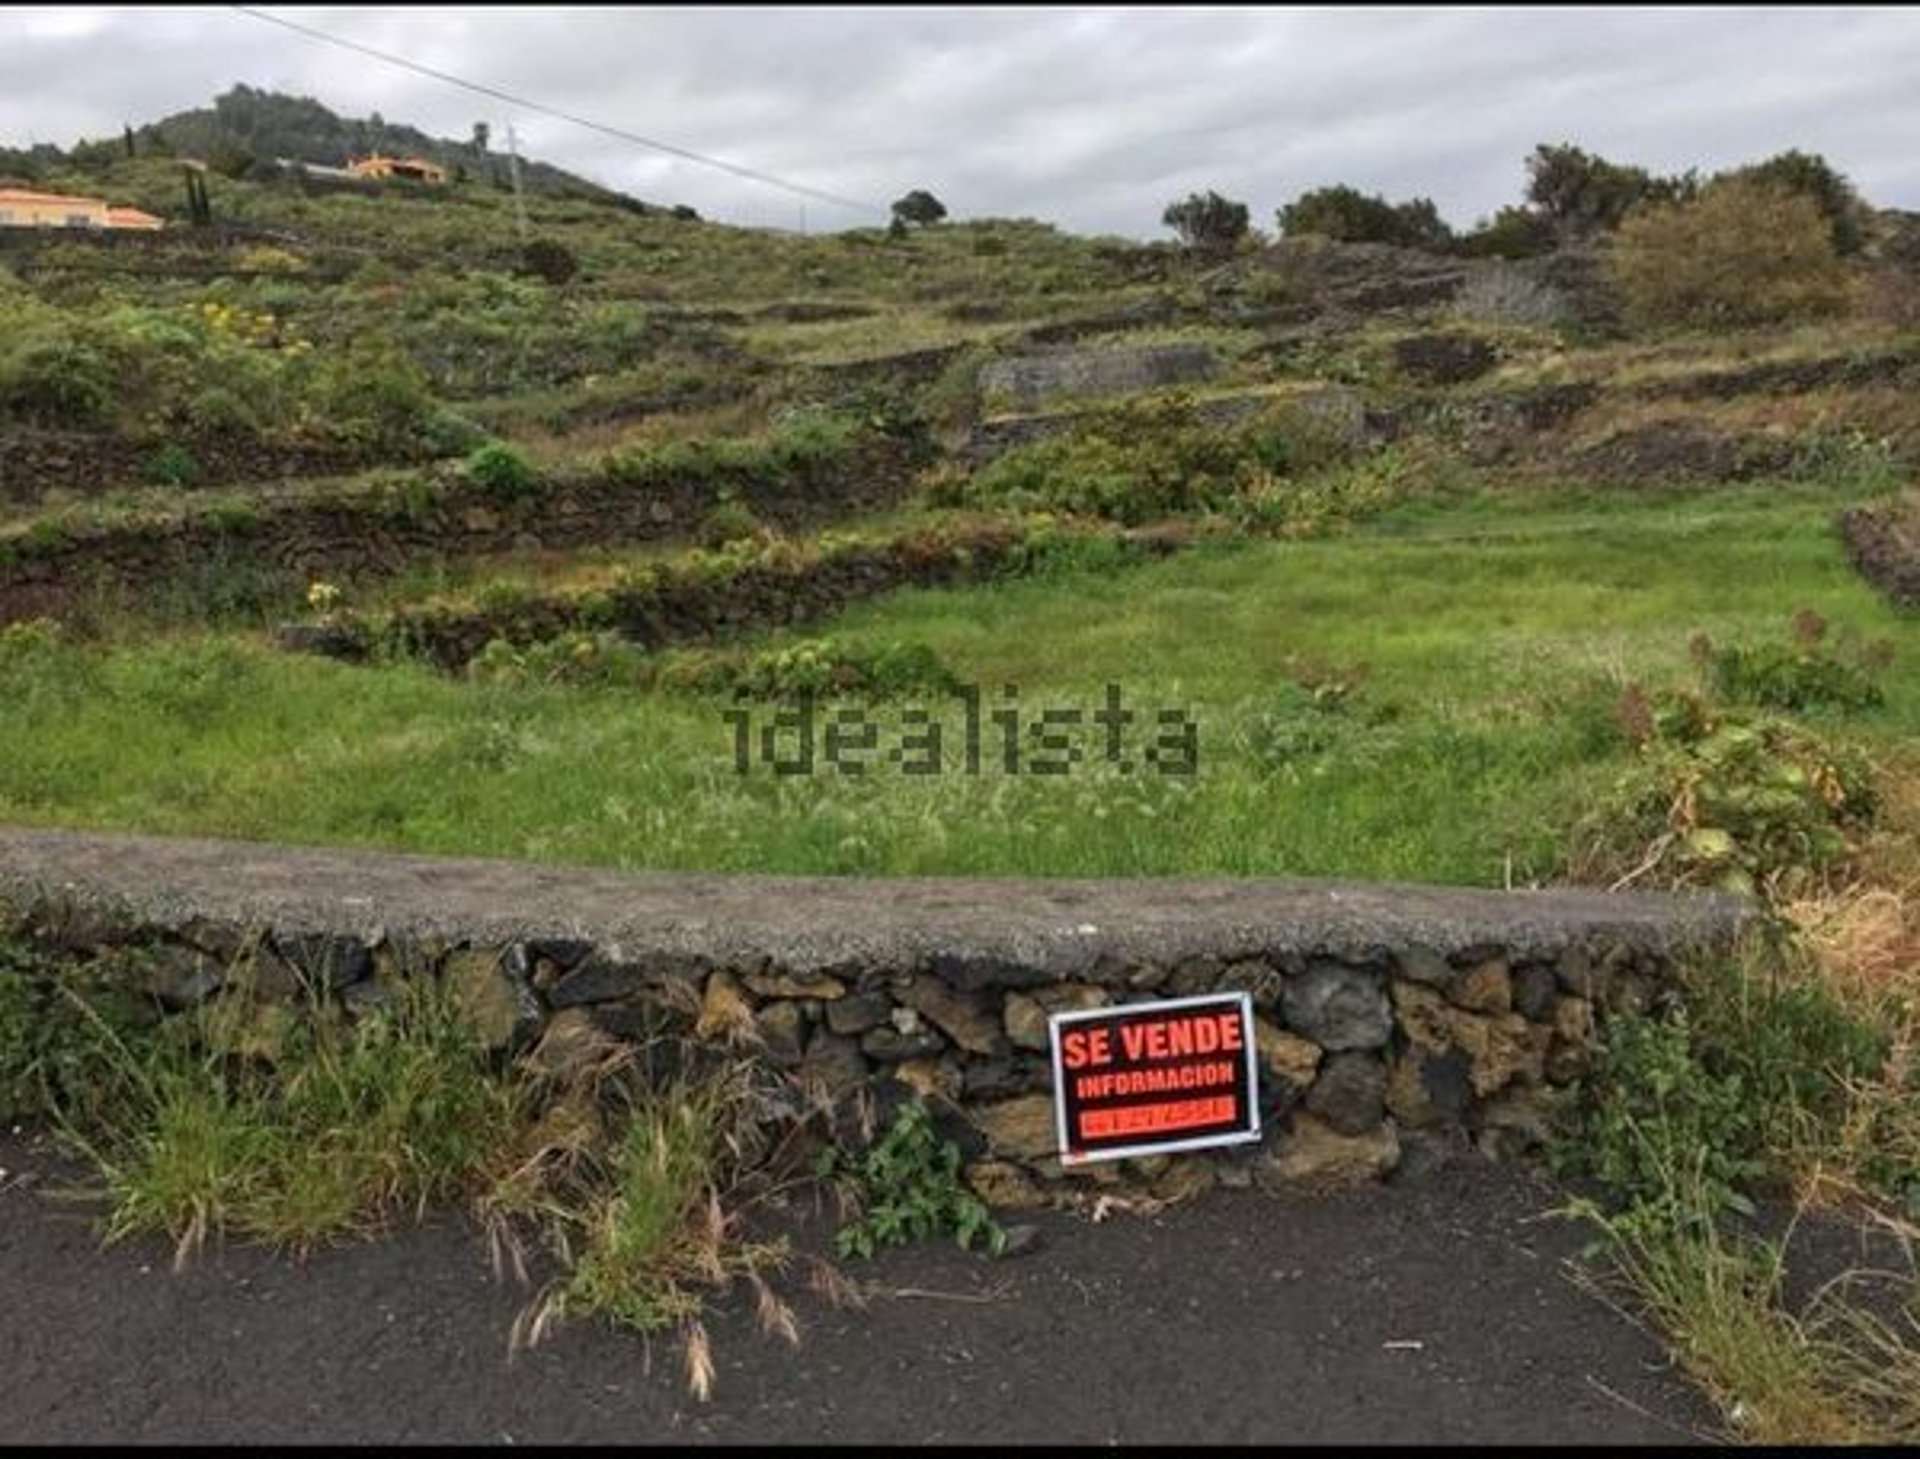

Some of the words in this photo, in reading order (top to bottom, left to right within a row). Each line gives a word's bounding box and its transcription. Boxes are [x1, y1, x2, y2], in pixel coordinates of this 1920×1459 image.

[1063, 1028, 1112, 1069] SE
[1120, 1013, 1243, 1062] VENDE
[1076, 1061, 1235, 1099] INFORMACION
